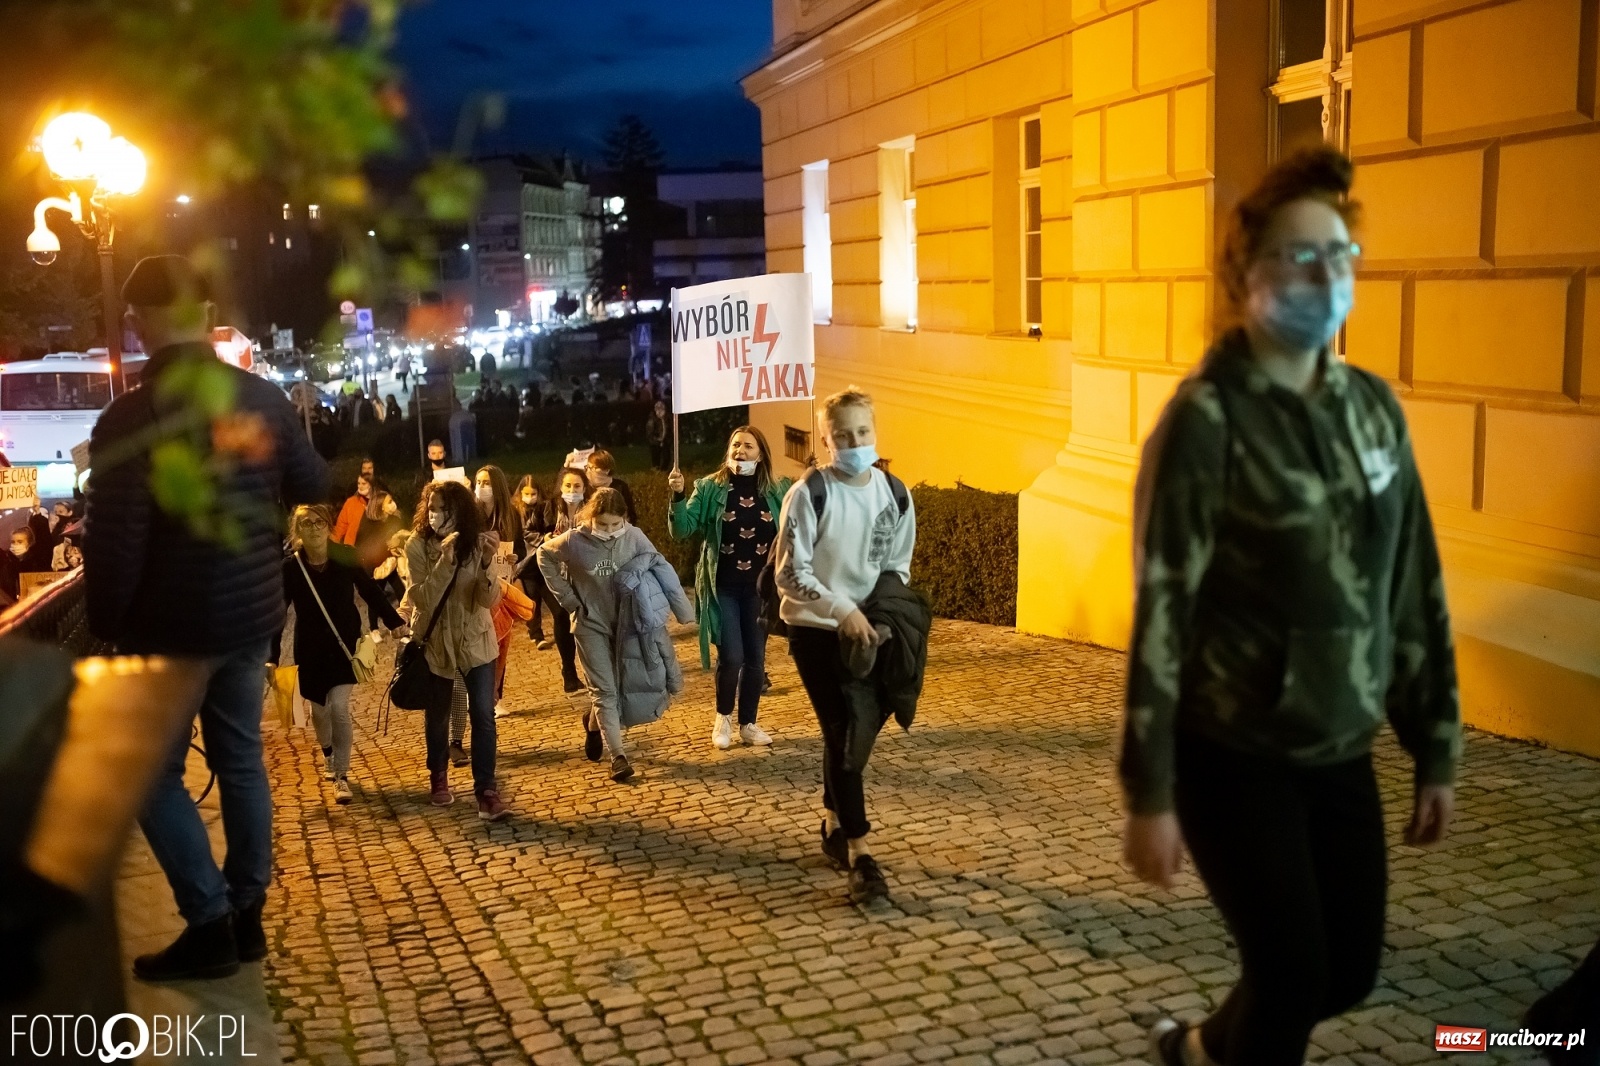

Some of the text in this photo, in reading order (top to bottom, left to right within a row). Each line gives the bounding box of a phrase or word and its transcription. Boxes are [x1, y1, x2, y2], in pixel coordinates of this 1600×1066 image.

[673, 295, 750, 343] WYBÓR
[716, 336, 753, 371] NIE
[740, 363, 815, 402] ZAKA
[7, 484, 37, 499] WYBÓR
[11, 468, 37, 483] CIAŁO
